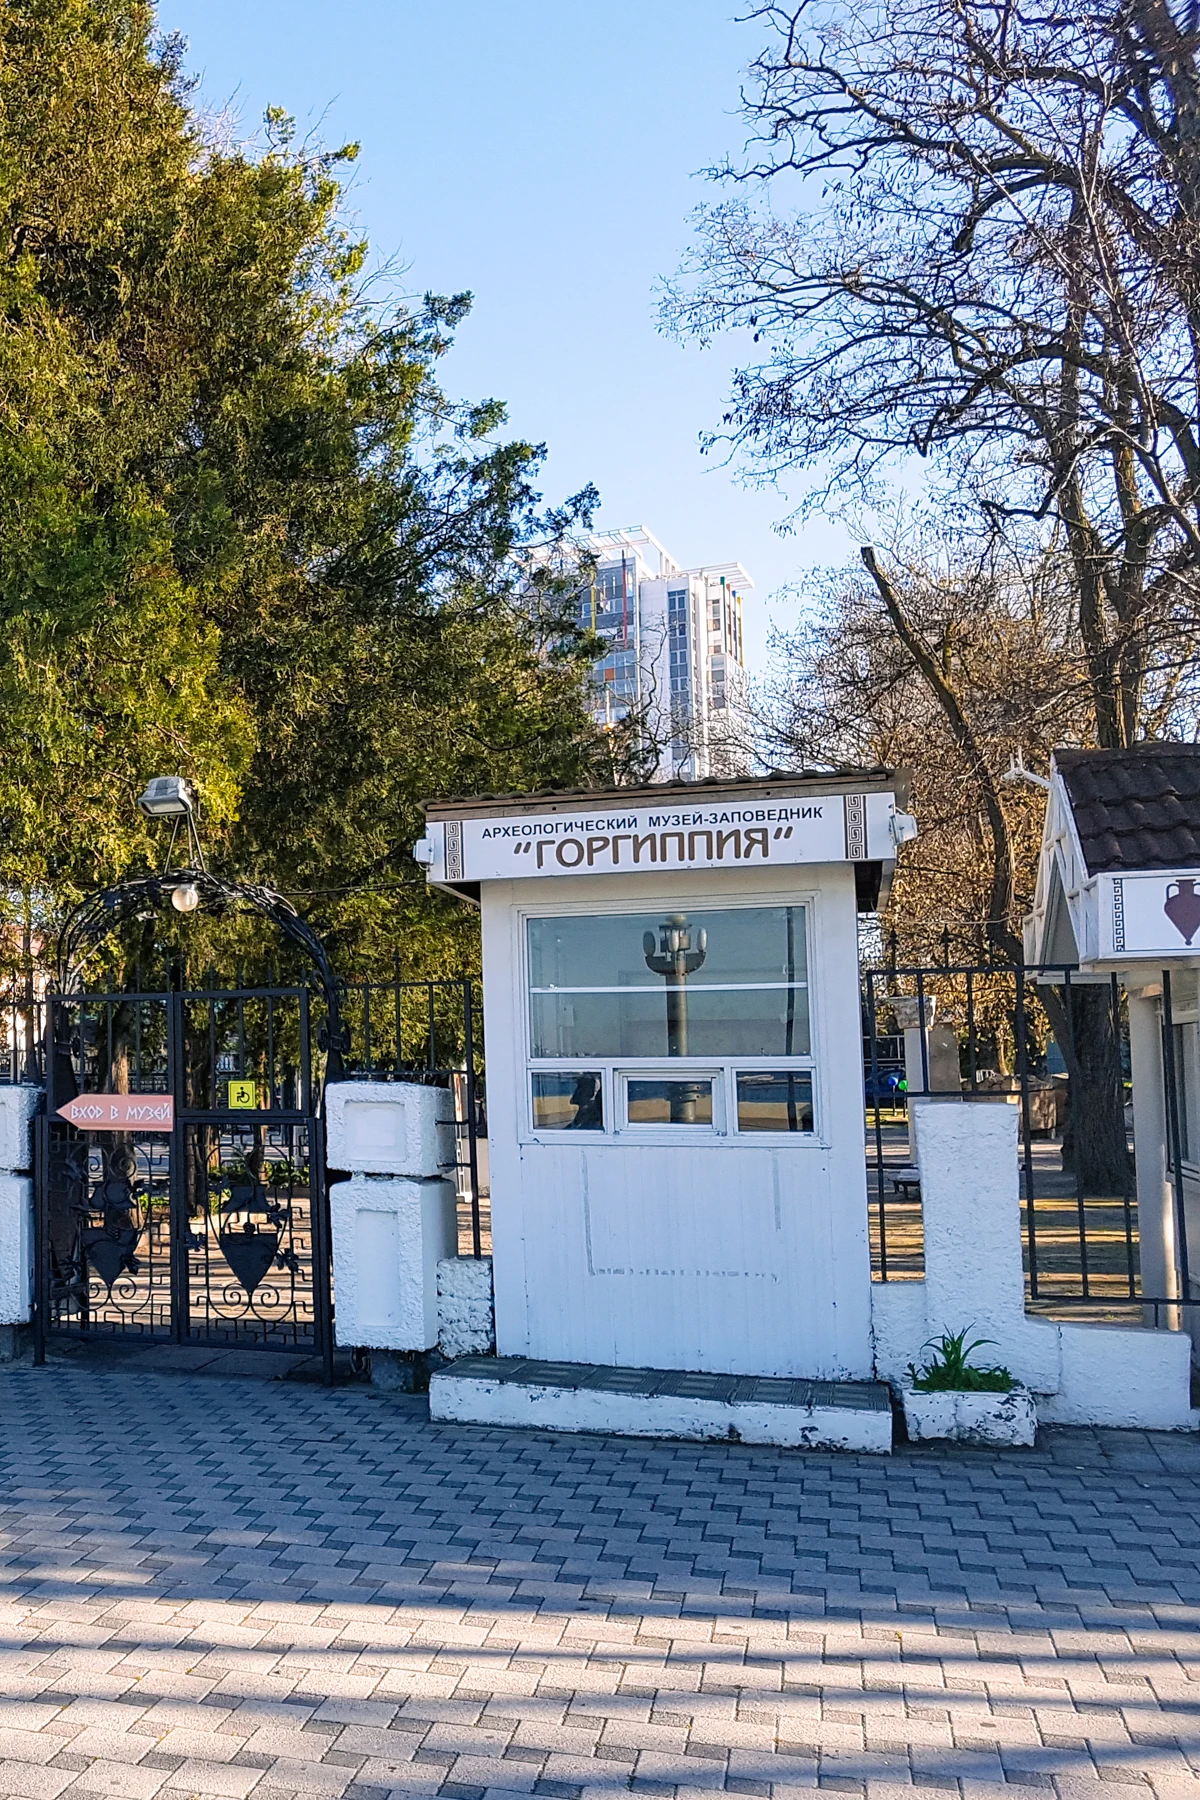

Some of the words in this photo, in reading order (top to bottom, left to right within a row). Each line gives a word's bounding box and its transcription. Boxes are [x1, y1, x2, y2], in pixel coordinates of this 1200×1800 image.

[481, 815, 638, 840] АРХЕОЛОГИЧЕСКИЙ
[647, 806, 823, 828] МУЗЕЙ-ЗАПОВЕДНИК
[513, 825, 794, 869] "ГОРГИППИЯ"
[71, 1104, 104, 1120] ВХОД
[110, 1105, 120, 1120] В
[126, 1103, 172, 1121] МУЗЕЙ
